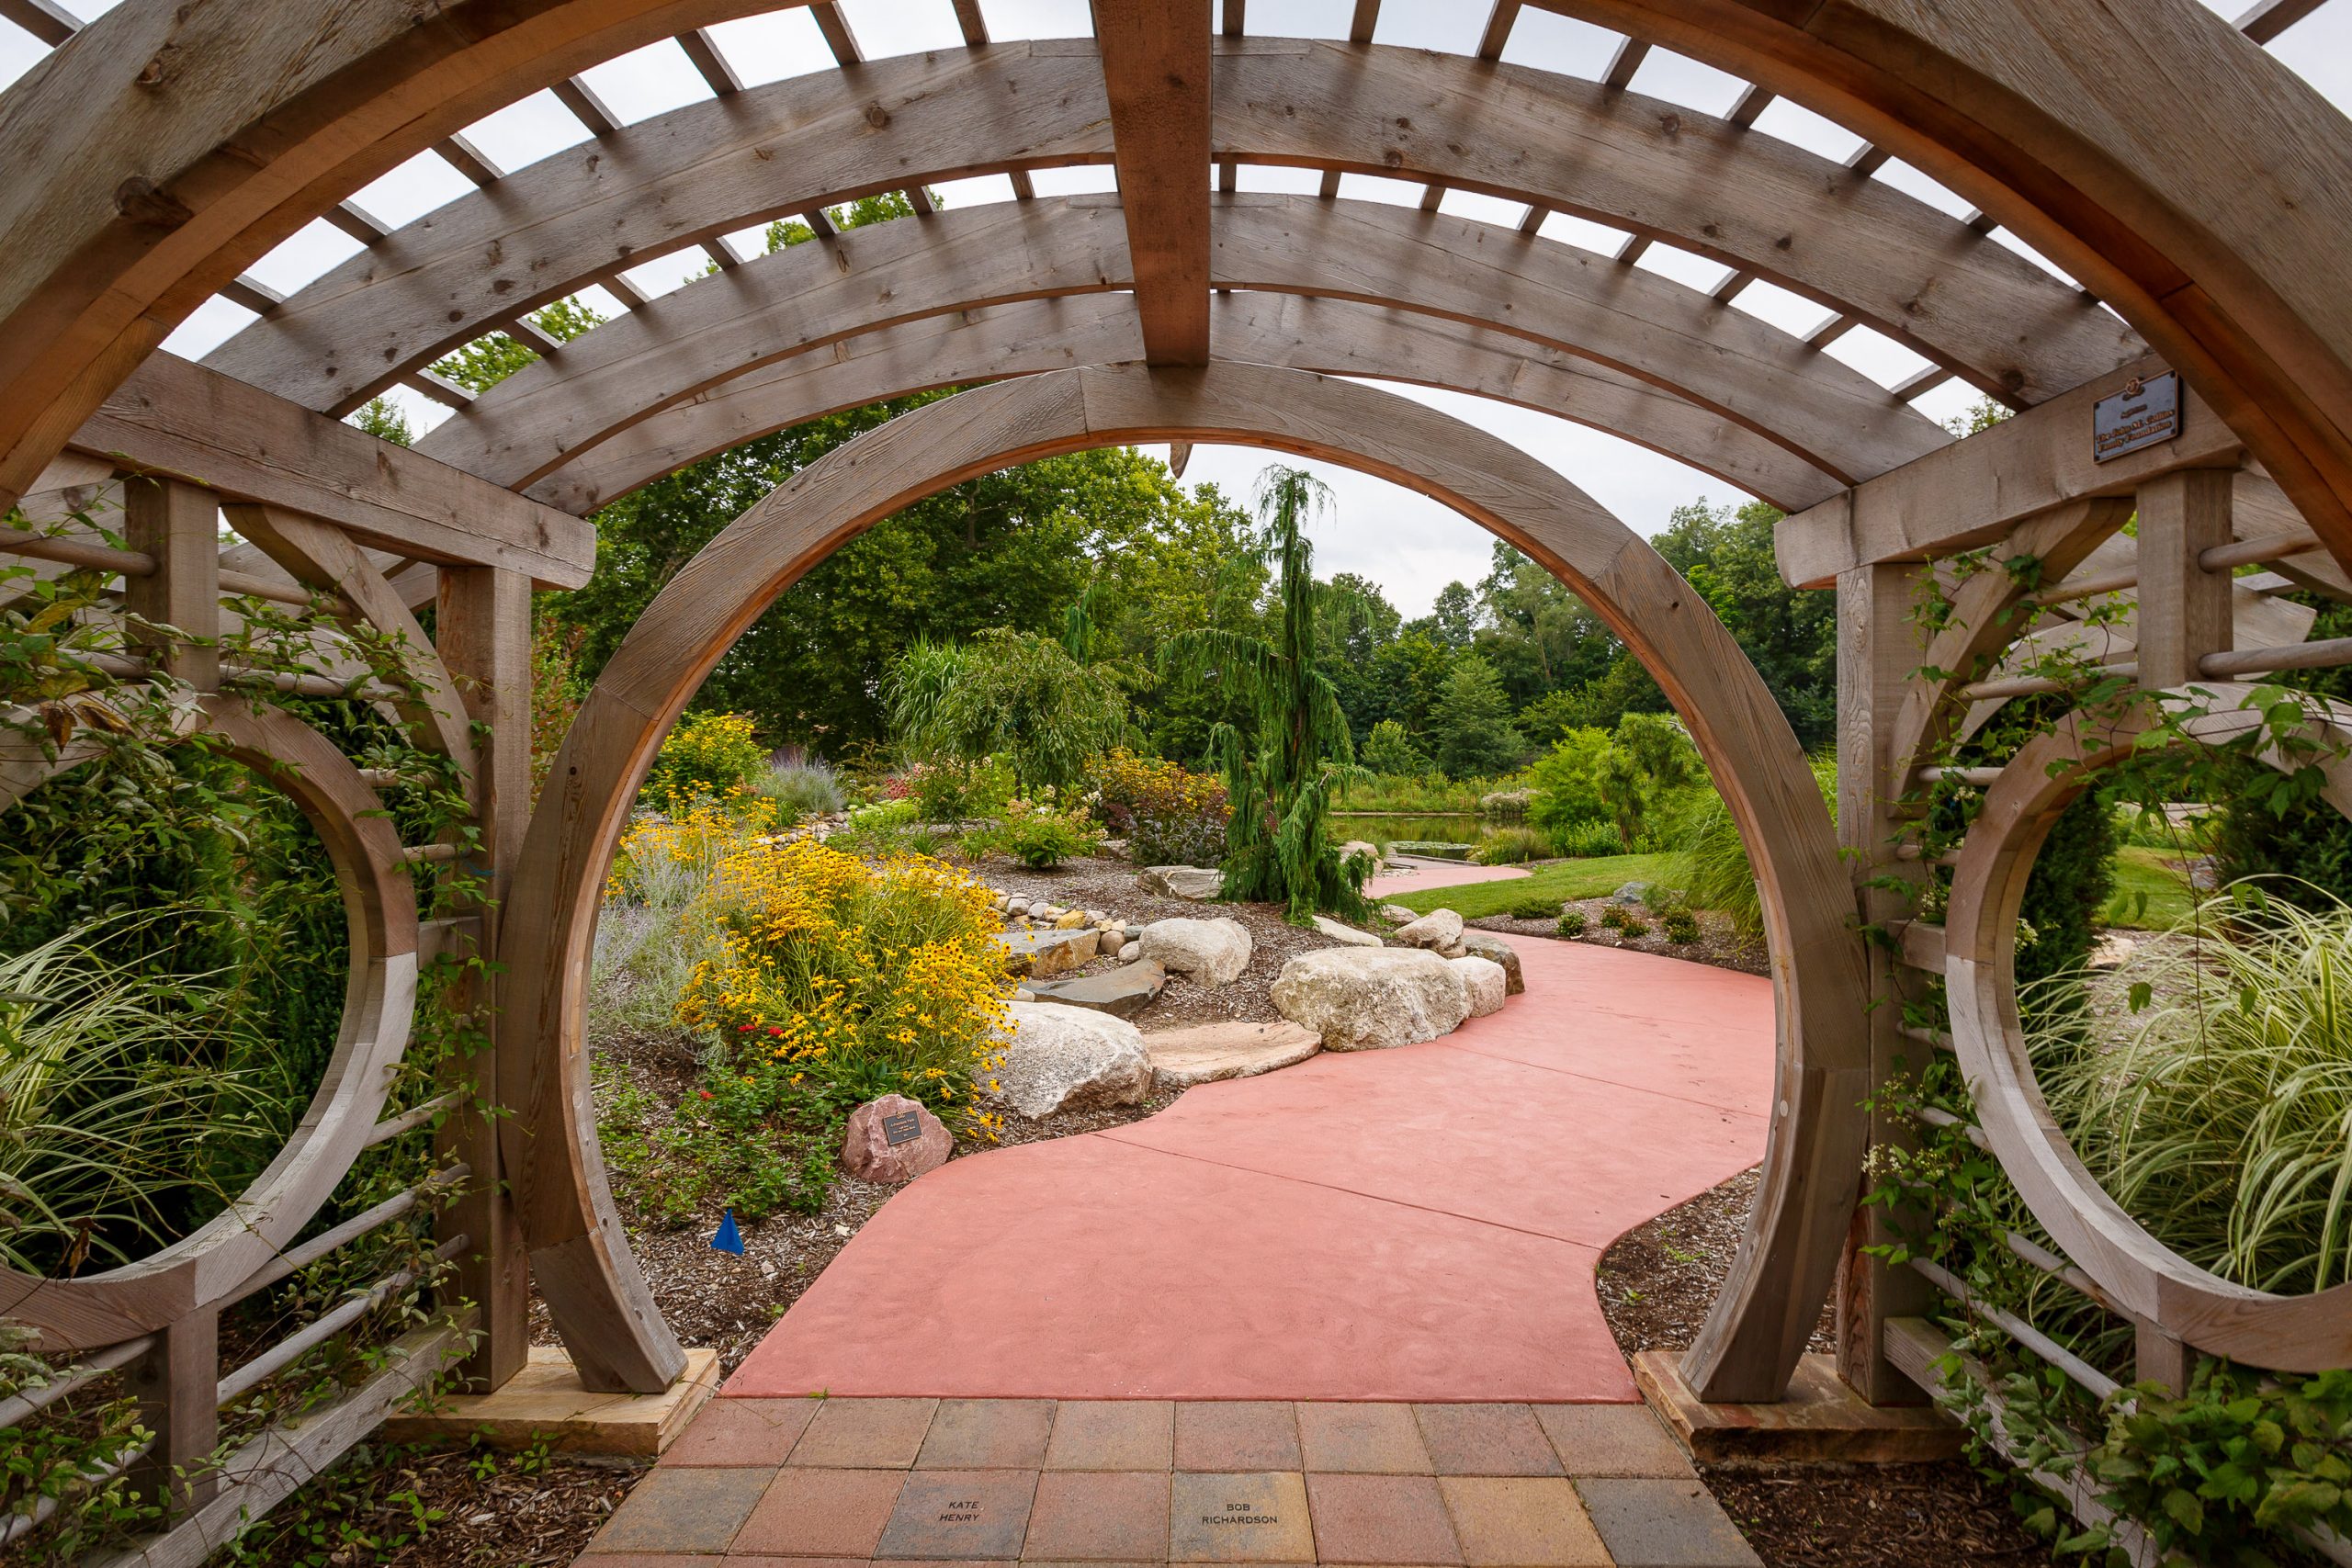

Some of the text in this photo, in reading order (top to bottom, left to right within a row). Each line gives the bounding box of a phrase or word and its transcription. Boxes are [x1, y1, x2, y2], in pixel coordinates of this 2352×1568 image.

[2097, 434, 2110, 443] The
[2111, 426, 2132, 436] John
[2145, 410, 2176, 424] Collins
[2098, 421, 2173, 453] Family Foundation
[948, 1501, 980, 1509] KATE
[1227, 1503, 1250, 1511] BOB
[938, 1513, 980, 1522] HENRY
[1202, 1516, 1278, 1524] RICHARDSON
